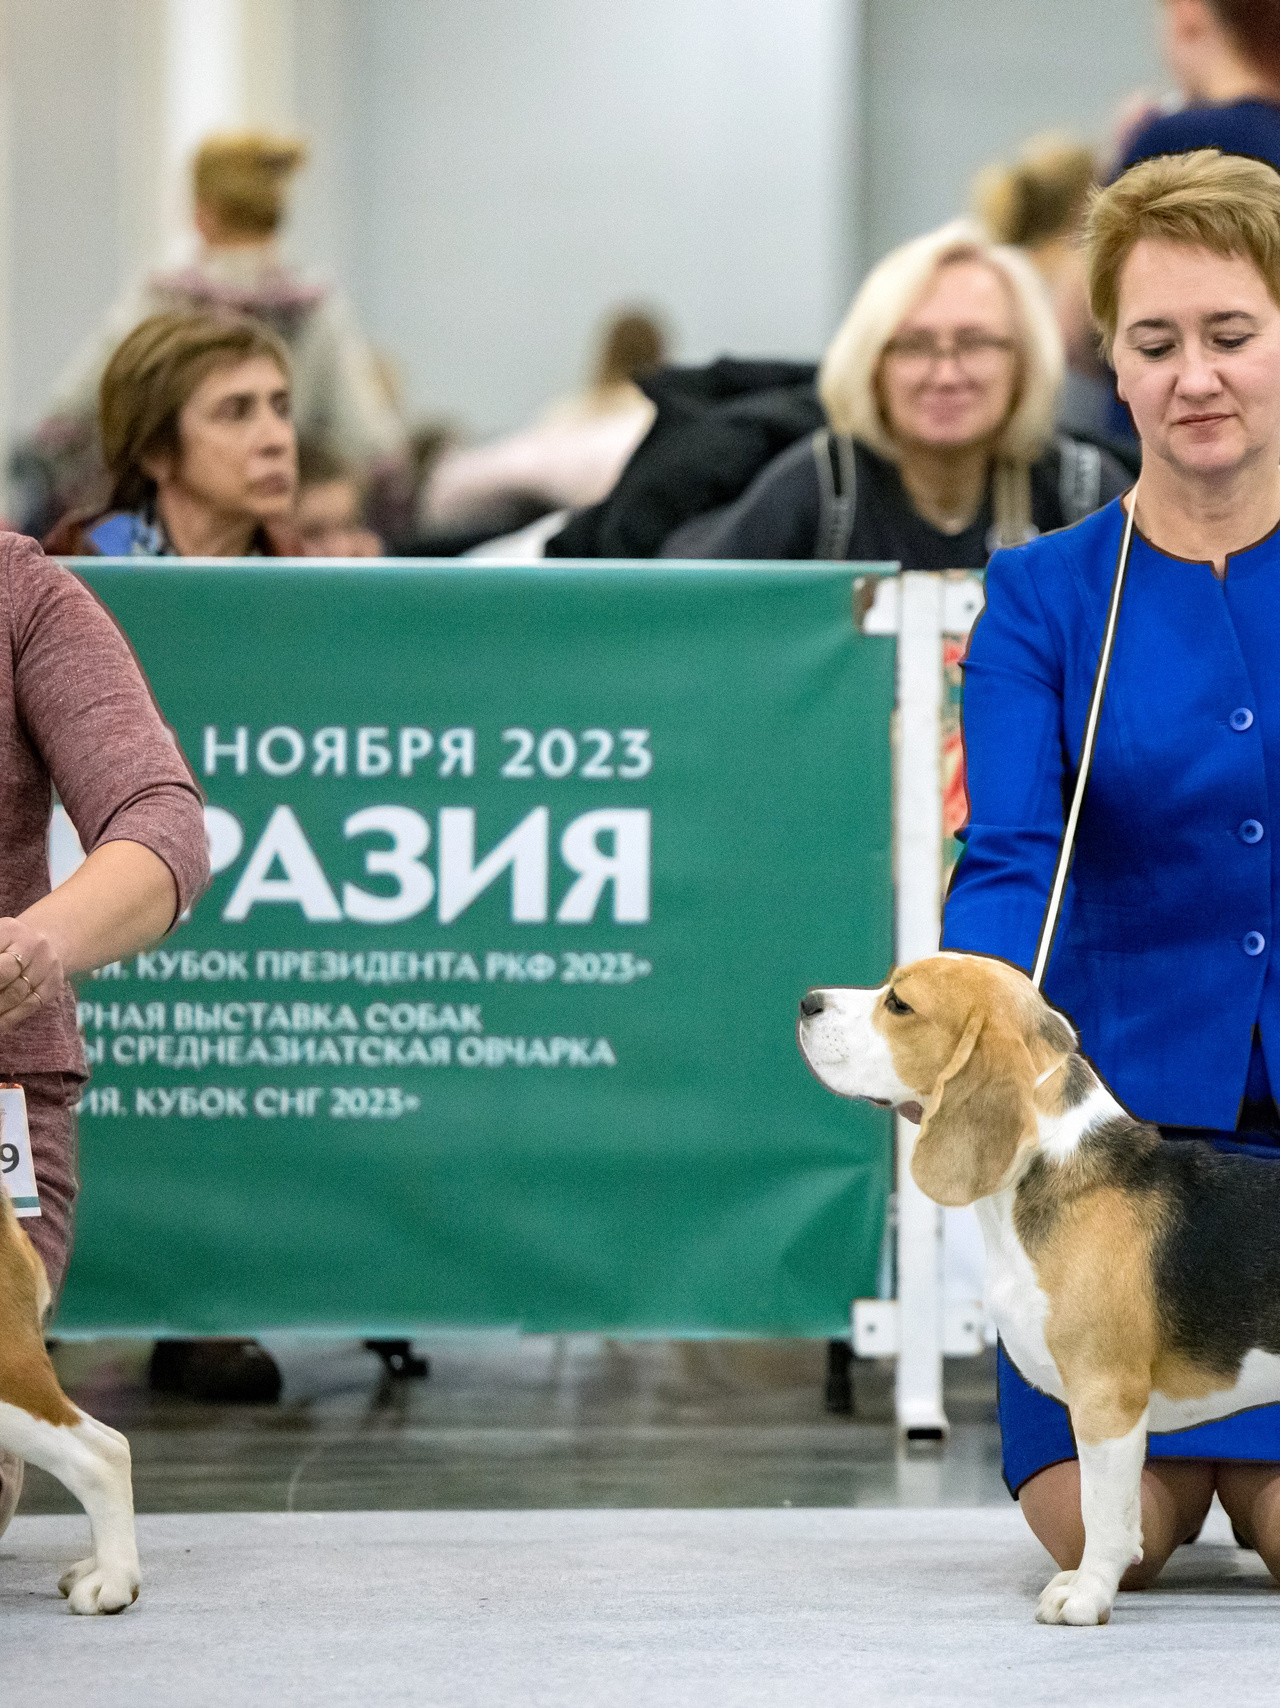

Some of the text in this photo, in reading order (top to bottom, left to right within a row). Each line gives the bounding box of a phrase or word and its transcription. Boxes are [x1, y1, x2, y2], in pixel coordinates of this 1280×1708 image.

[202, 725, 654, 779] НОЯБРЯ 2023
[135, 949, 249, 982] КУБОК
[255, 949, 481, 985] ПРЕЗИДЕНТА
[485, 952, 557, 983] РКФ
[173, 1001, 360, 1033] ВЫСТАВКА
[364, 1001, 484, 1034] СОБАК
[111, 1035, 452, 1069] СРЕДНЕАЗИАТСКАЯ
[455, 1035, 618, 1068] ОВЧАРКА
[134, 1086, 249, 1118] КУБОК
[253, 1087, 322, 1118] СНГ
